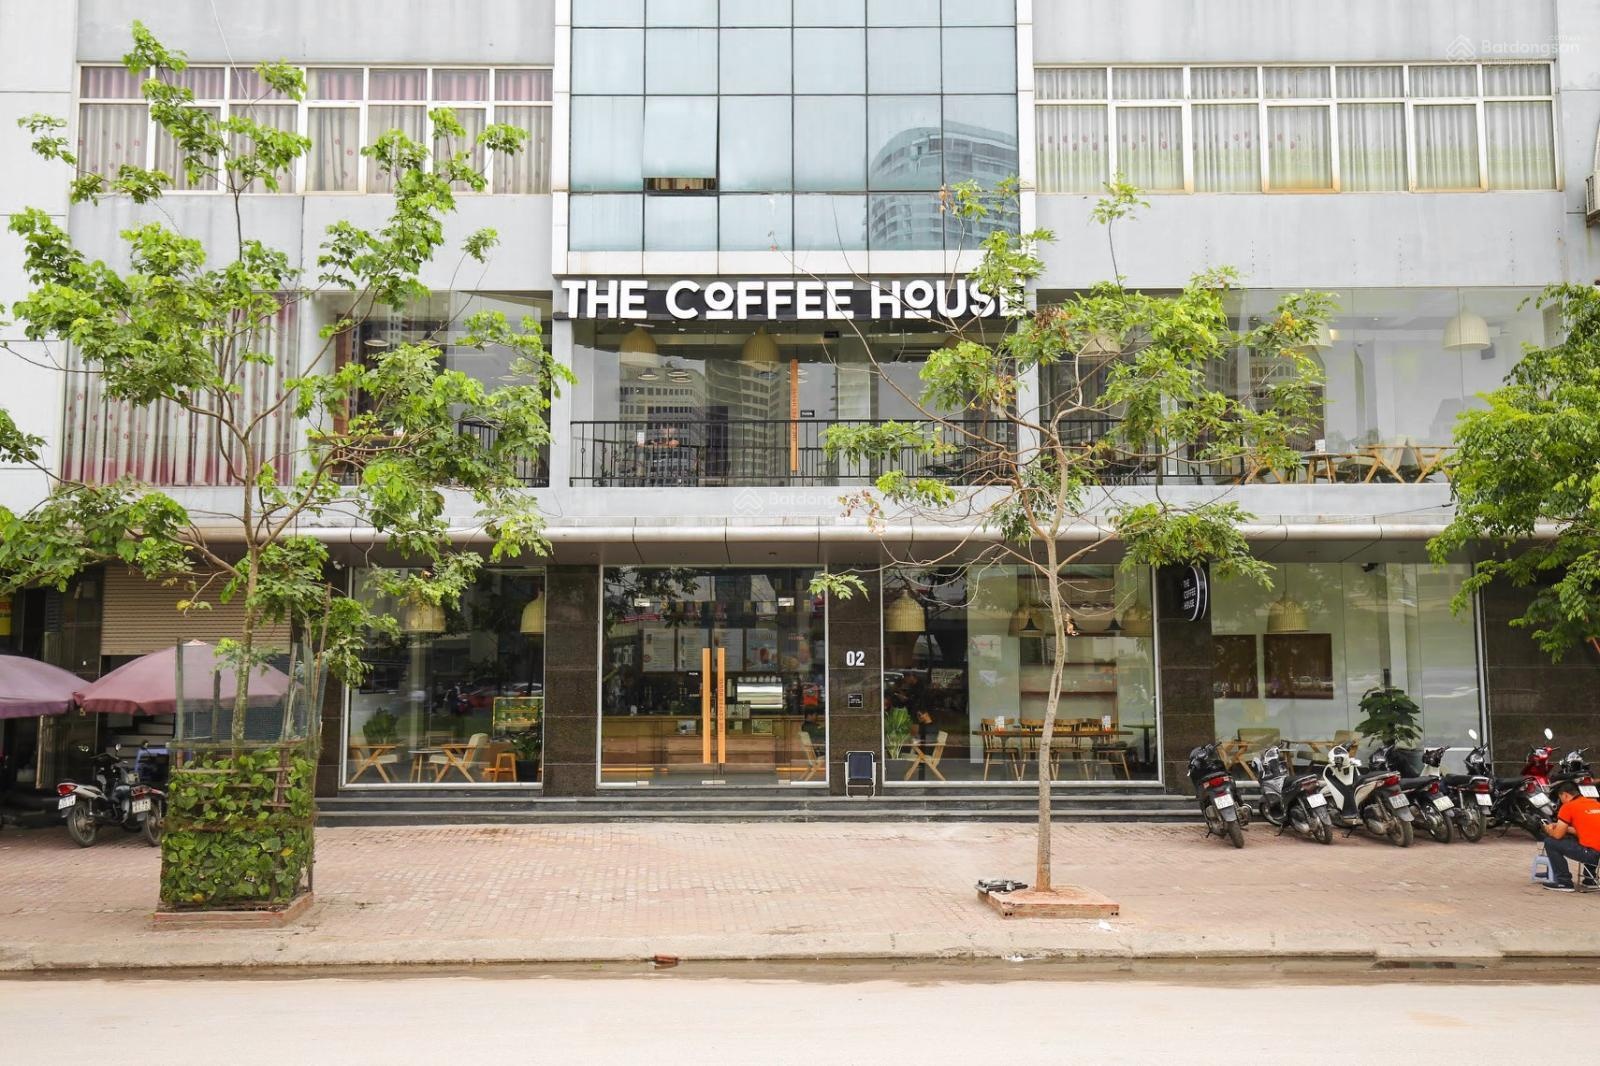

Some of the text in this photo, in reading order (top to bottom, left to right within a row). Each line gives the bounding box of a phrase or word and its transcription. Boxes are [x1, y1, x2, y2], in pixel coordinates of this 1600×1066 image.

[564, 280, 648, 320] THE
[665, 280, 854, 320] COFFEE
[846, 651, 865, 667] 02
